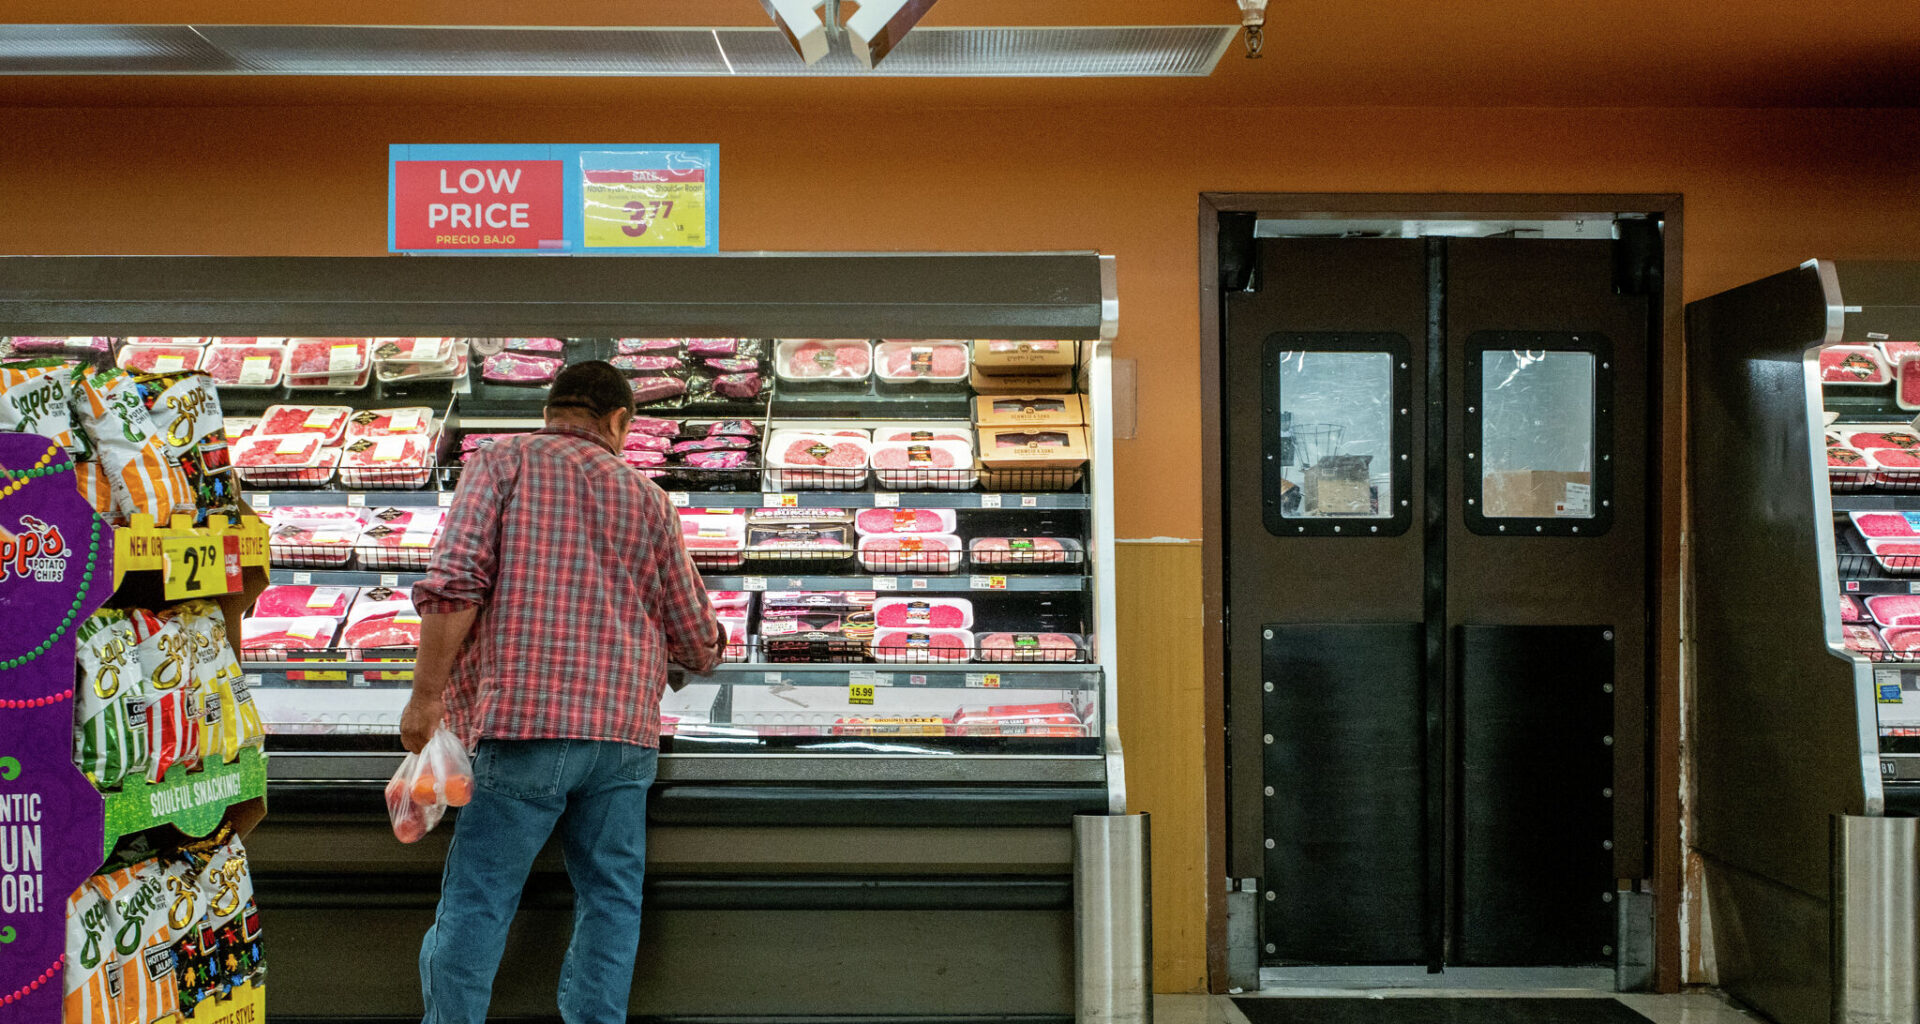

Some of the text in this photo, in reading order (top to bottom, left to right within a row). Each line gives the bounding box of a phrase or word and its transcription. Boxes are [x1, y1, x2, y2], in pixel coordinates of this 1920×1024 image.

[439, 168, 522, 194] LOW
[428, 203, 530, 228] PRICE
[436, 234, 516, 245] PRECIO BAJO
[130, 535, 148, 557] NEW
[246, 537, 263, 556] STYLE
[33, 559, 66, 570] POTATO
[36, 571, 63, 581] CHIPS
[850, 687, 873, 697] 15.99
[150, 772, 241, 818] SOULFUL SNACKING!
